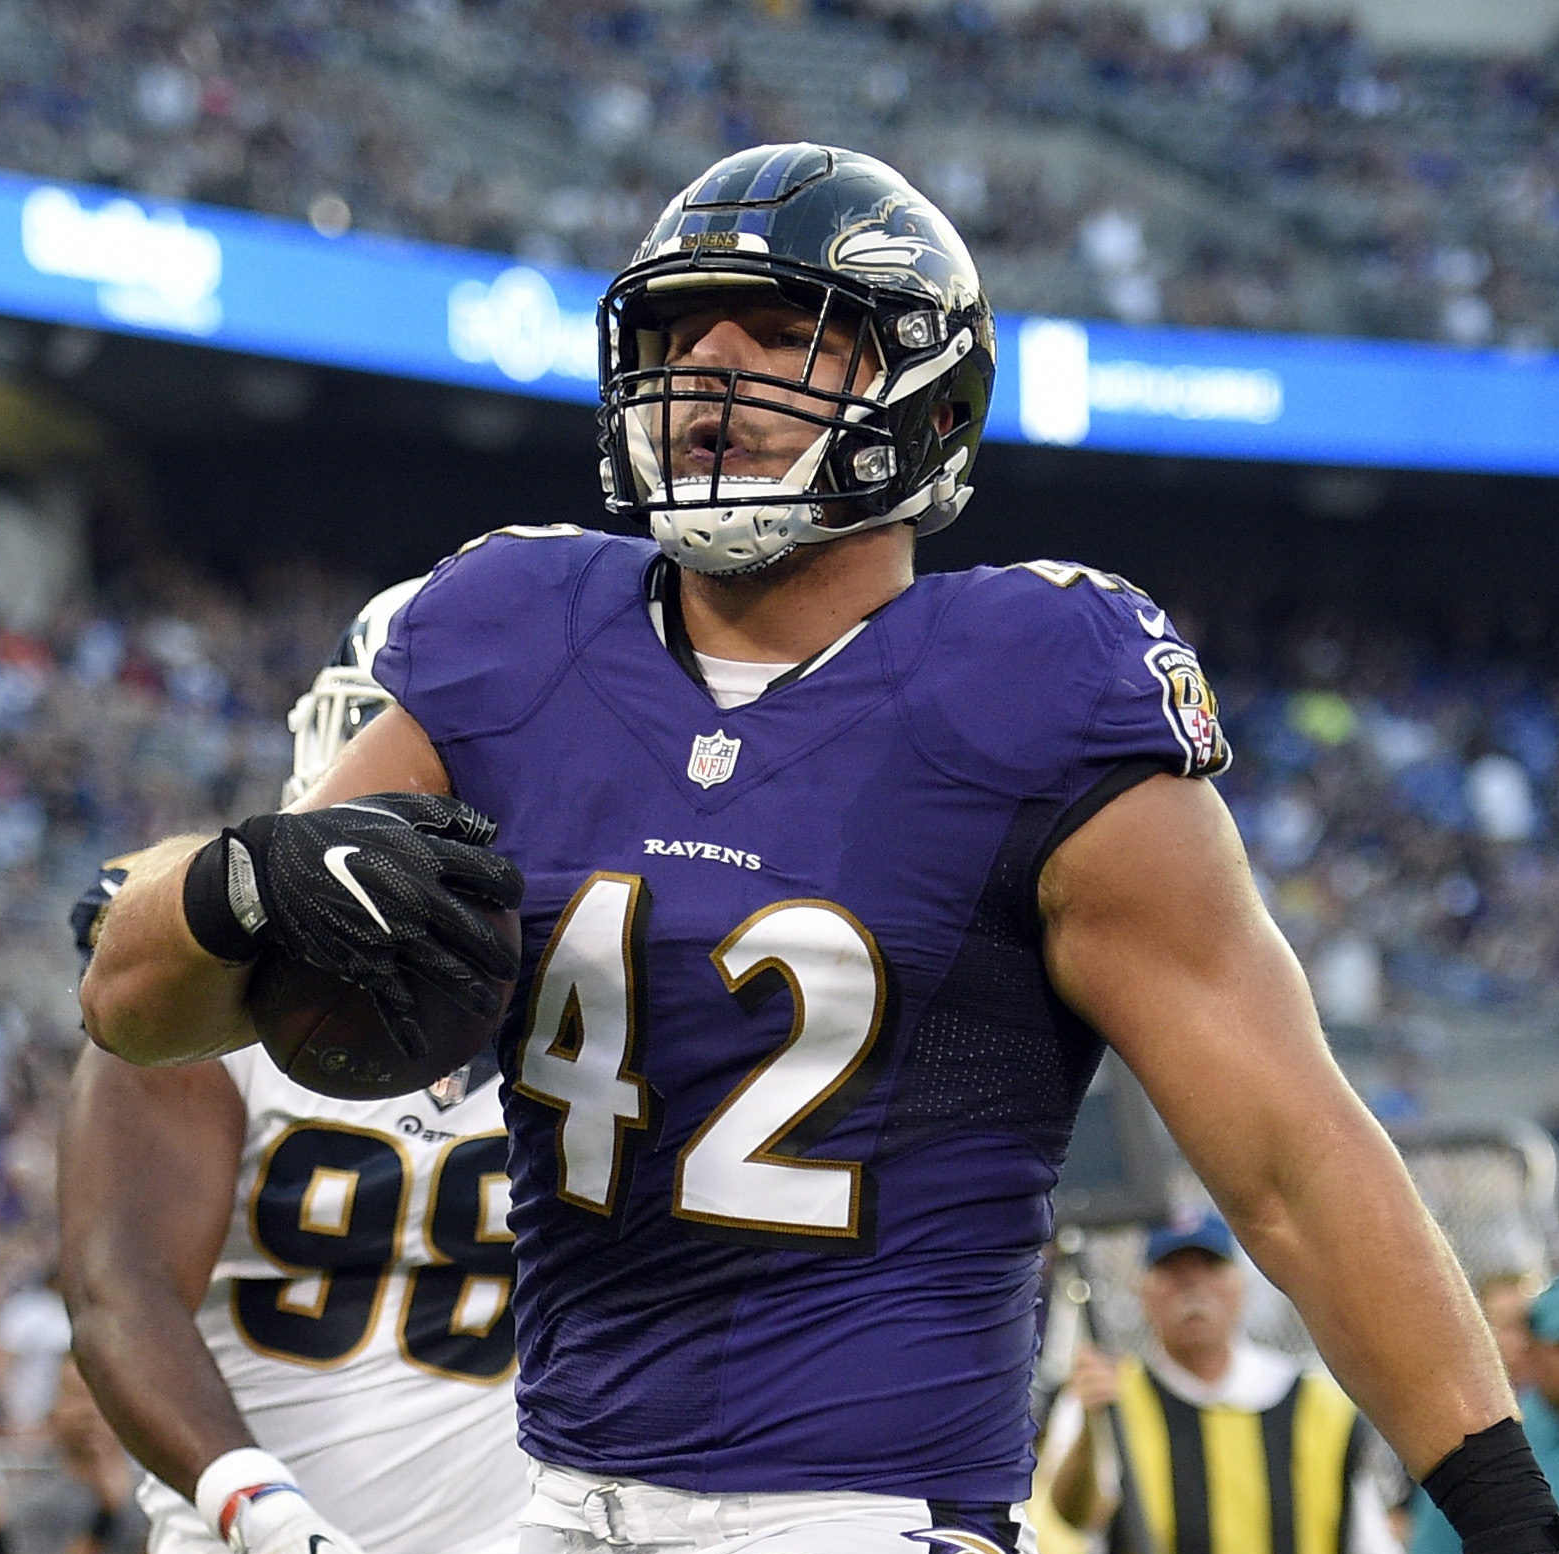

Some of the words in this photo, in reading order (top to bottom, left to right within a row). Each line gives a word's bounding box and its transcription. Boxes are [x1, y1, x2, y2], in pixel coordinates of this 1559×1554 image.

[696, 756, 727, 778] NFL
[643, 838, 762, 871] RAVENS
[513, 870, 887, 1240] 42
[230, 1118, 521, 1387] 98
